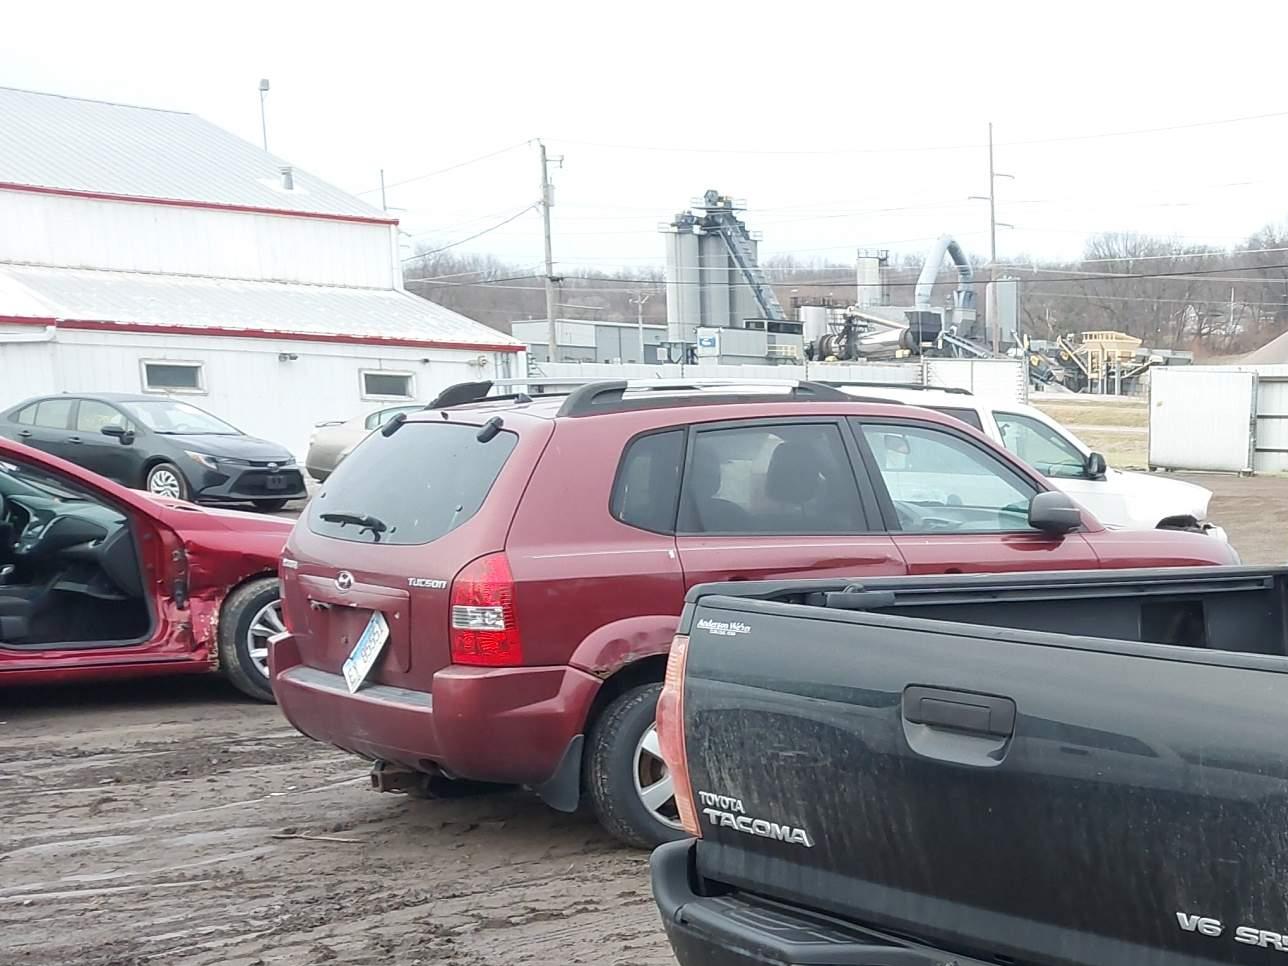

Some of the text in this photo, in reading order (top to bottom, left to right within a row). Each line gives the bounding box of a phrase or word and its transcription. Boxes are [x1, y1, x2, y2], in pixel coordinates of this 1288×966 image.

[408, 577, 448, 589] TUCSON
[698, 790, 746, 815] TOYOTA
[702, 807, 816, 848] TACOMA
[1175, 911, 1223, 938] V6
